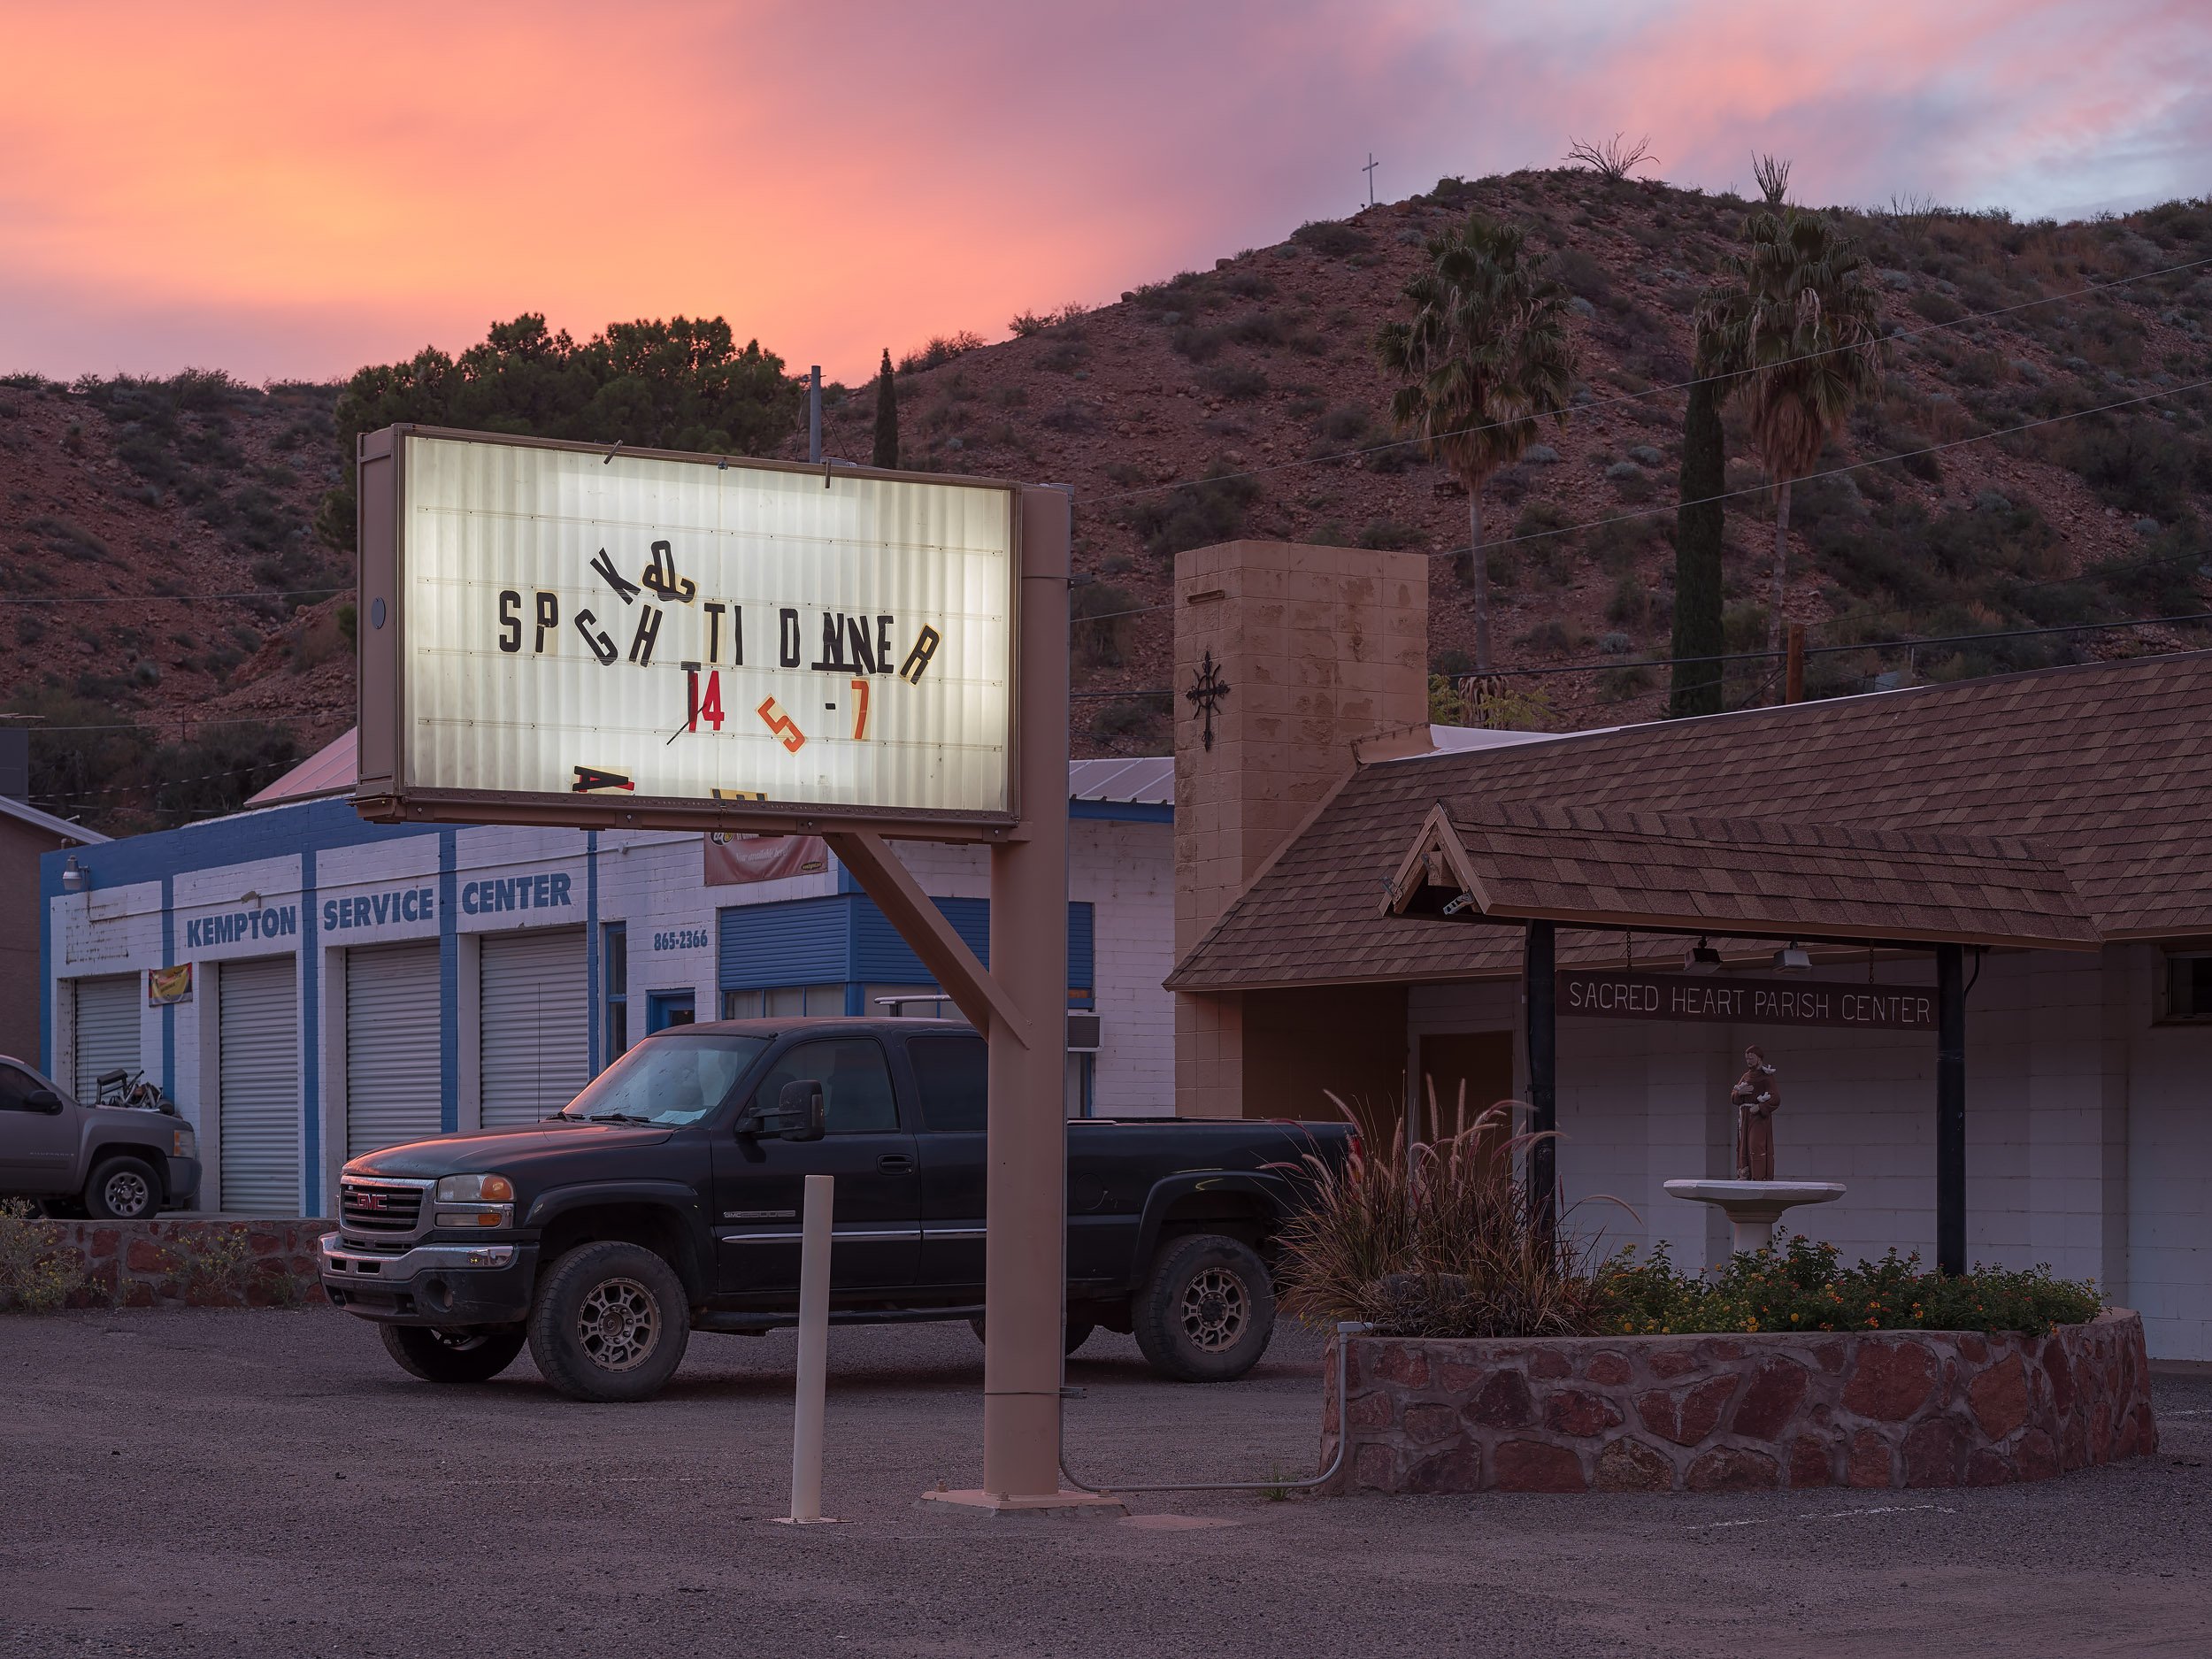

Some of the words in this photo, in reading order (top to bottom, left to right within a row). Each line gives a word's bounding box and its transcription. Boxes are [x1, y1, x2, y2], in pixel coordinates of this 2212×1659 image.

[187, 905, 296, 948] KEMPTON
[323, 888, 434, 931] SERVICE
[462, 872, 572, 915] CENTER
[654, 929, 708, 951] 865-2366
[1569, 981, 1659, 1011] SACRED
[1671, 987, 1745, 1015] HEART
[1755, 990, 1830, 1019] PARISH
[1841, 994, 1931, 1024] CENTER
[357, 1193, 388, 1211] GMC
